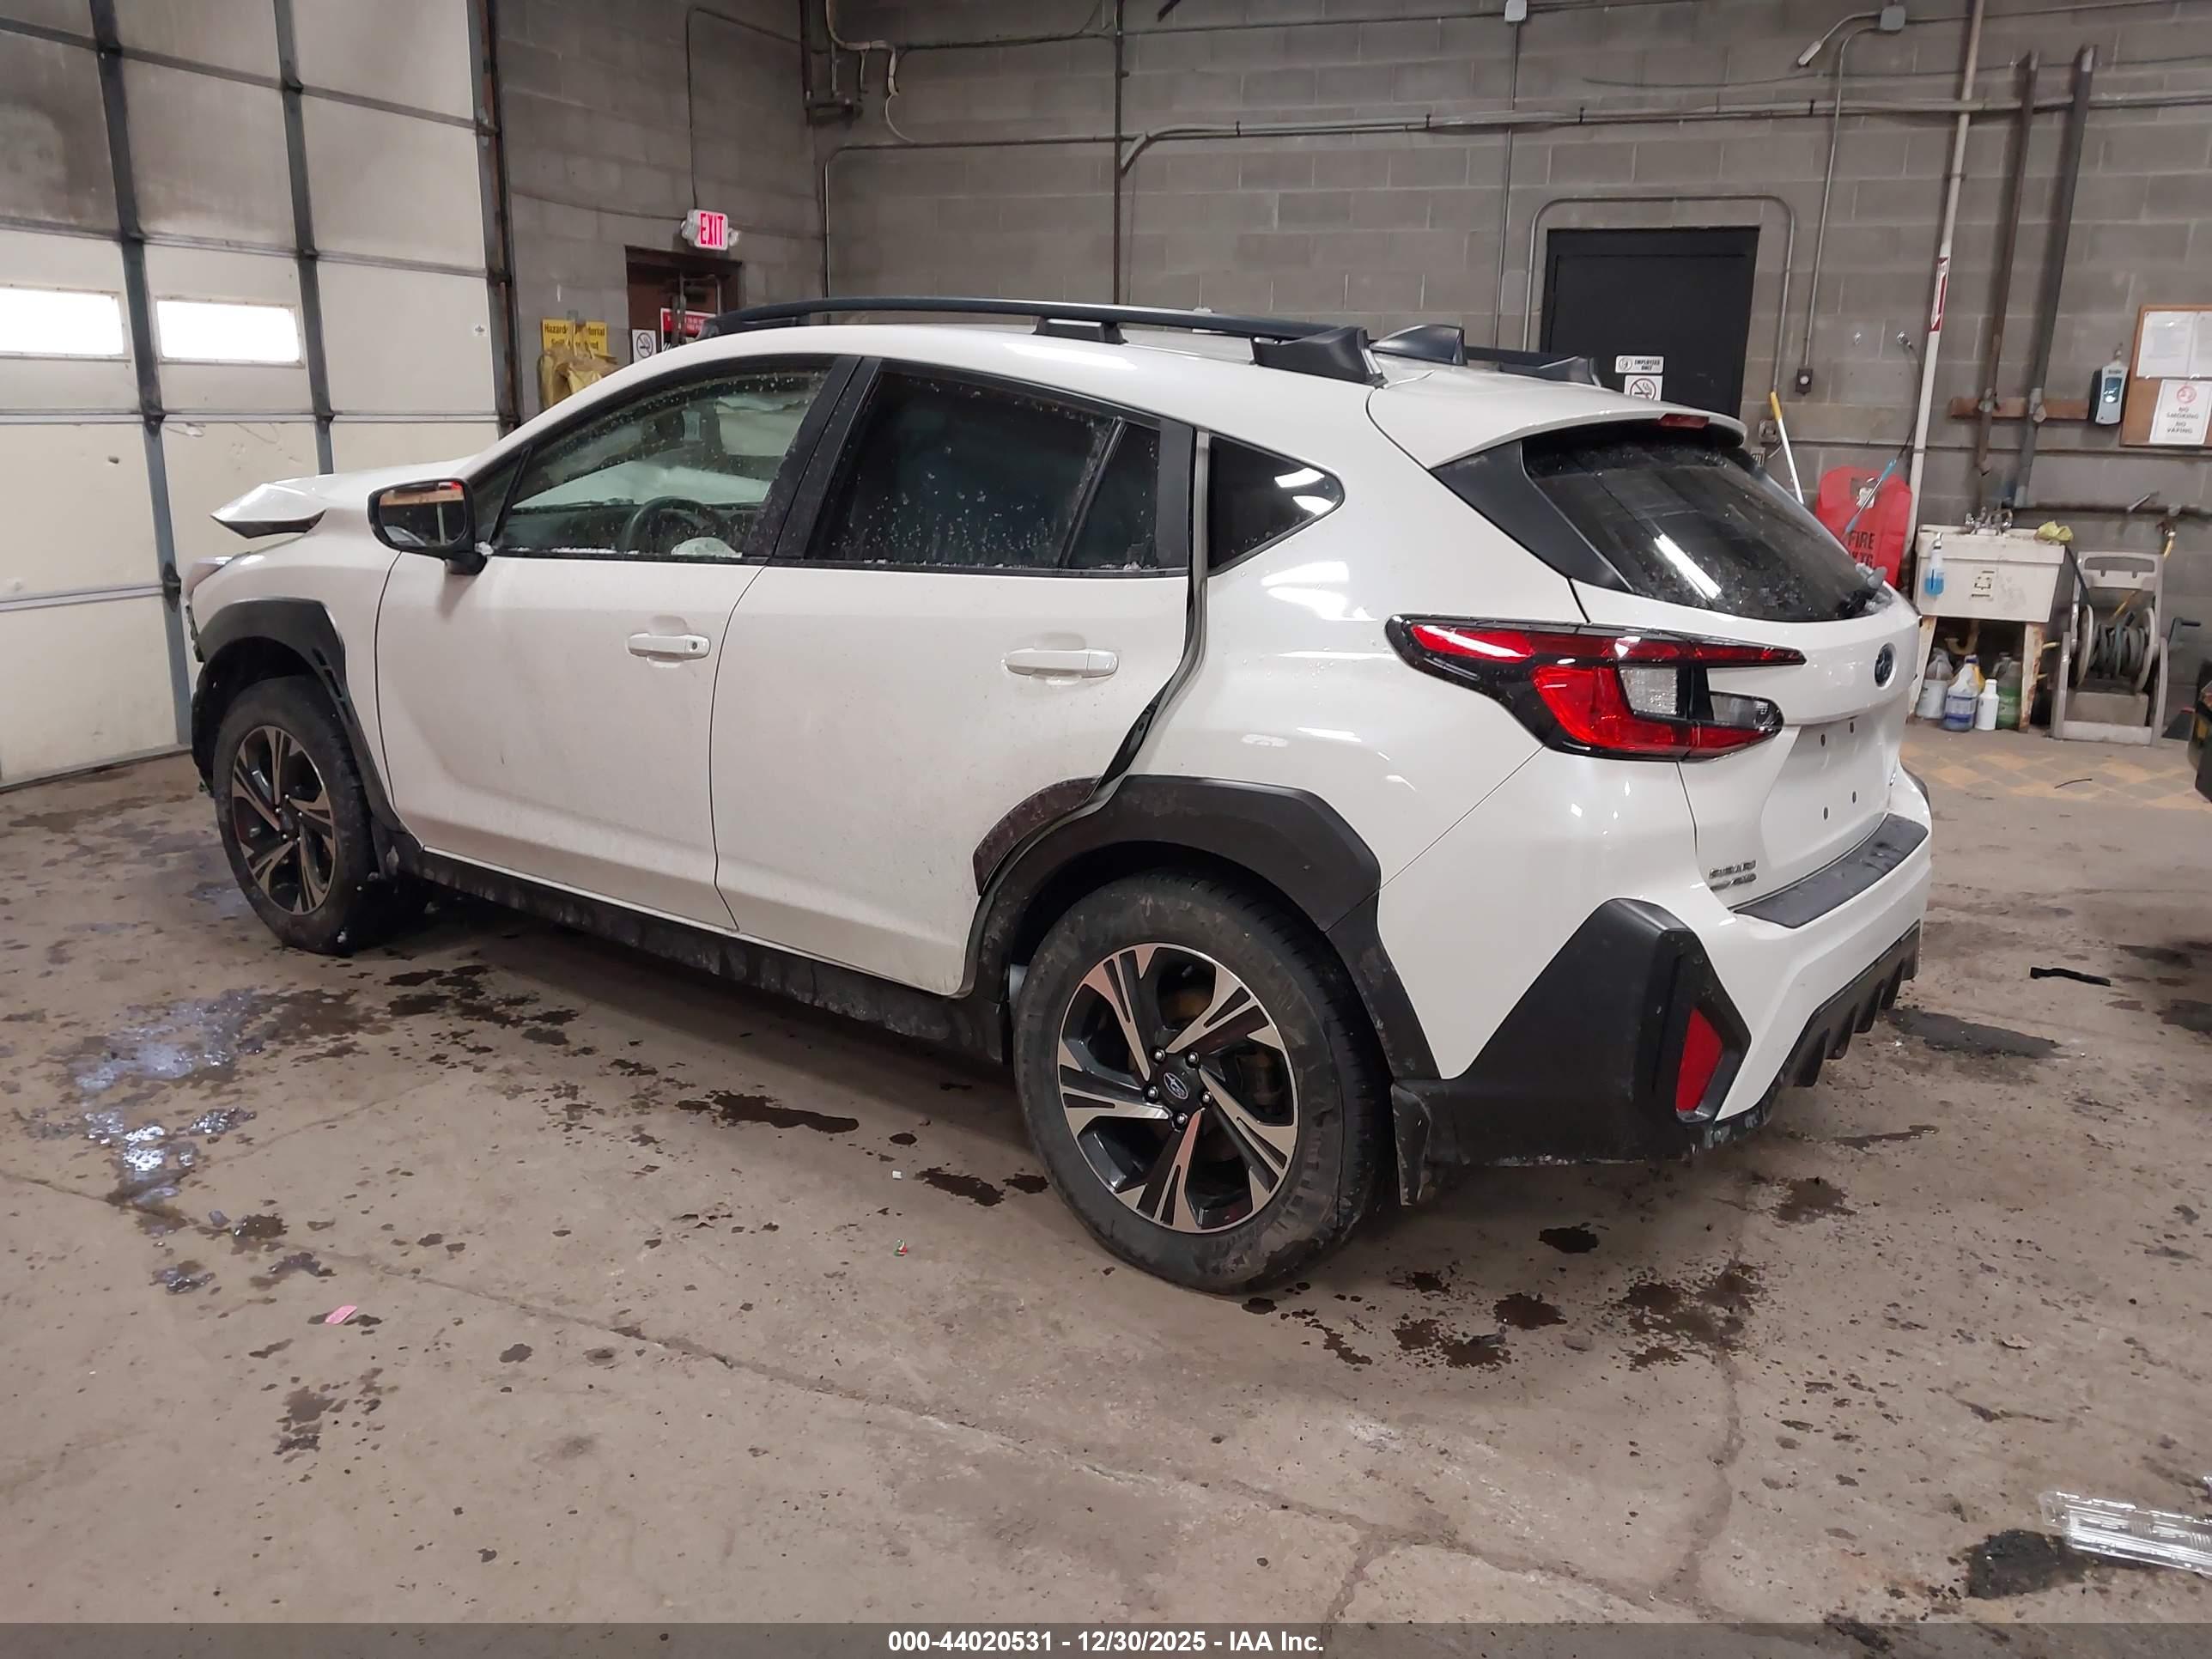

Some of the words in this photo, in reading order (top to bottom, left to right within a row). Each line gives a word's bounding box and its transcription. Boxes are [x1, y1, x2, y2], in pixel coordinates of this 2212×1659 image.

[700, 213, 724, 246] EXIT
[1847, 530, 1875, 550] FIRE
[1850, 550, 1874, 568] XTG
